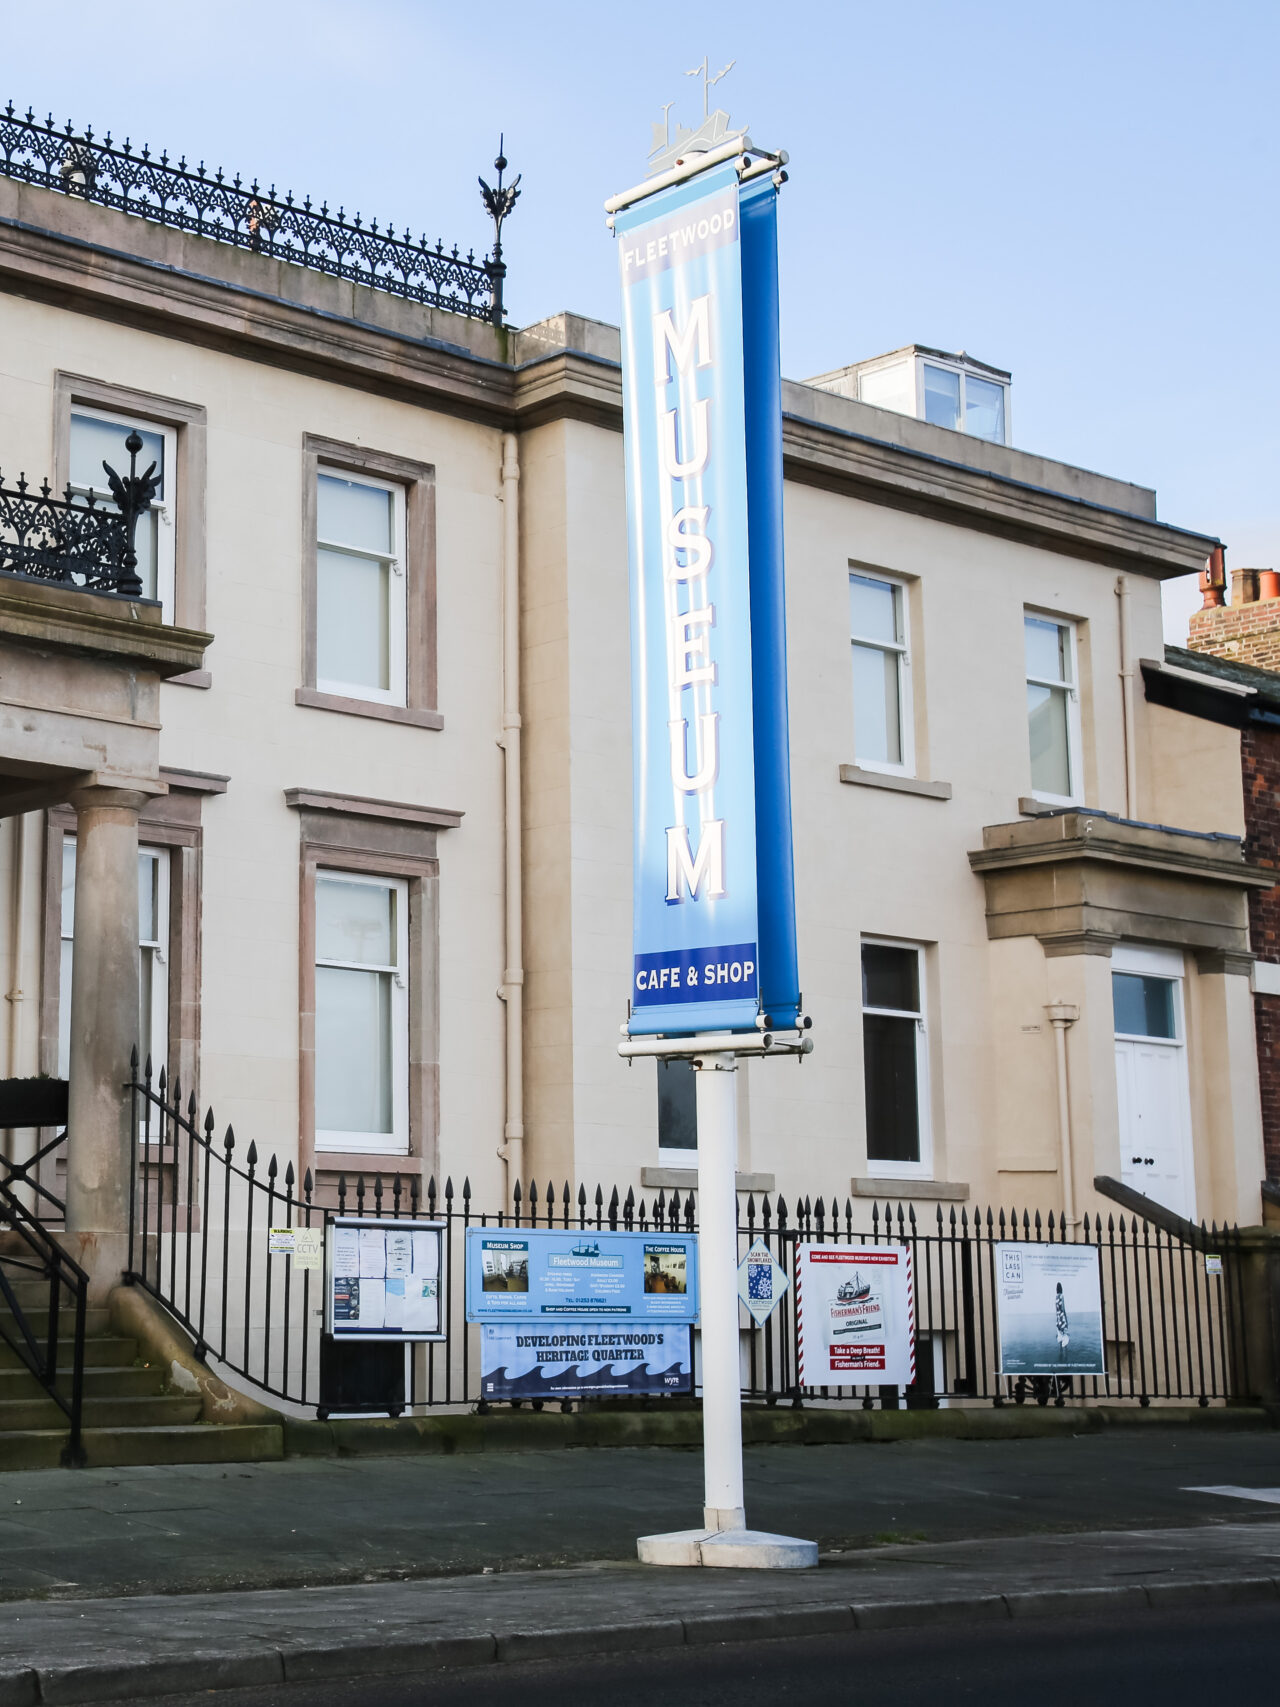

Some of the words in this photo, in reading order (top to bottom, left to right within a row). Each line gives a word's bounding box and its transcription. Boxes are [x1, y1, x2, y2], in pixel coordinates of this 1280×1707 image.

[624, 208, 736, 271] FLEETWOOD
[652, 294, 729, 904] MUSEUM
[636, 967, 680, 990] CAFE
[686, 966, 698, 986] &
[704, 961, 754, 985] SHOP
[297, 1244, 319, 1254] CCTV
[553, 1256, 589, 1266] Fleetwood
[589, 1258, 619, 1267] Museum
[1005, 1253, 1020, 1261] THIS
[1006, 1272, 1021, 1280] CAN
[845, 1319, 868, 1327] ORIGINAL
[516, 1335, 586, 1348] DEVELOPING
[587, 1333, 664, 1346] FLEETWOOD'S
[536, 1350, 589, 1362] HERITAGE
[592, 1349, 644, 1362] QUARTER
[834, 1346, 846, 1354] Take
[850, 1347, 862, 1355] Deep
[834, 1360, 863, 1368] Fisherman's
[664, 1377, 680, 1386] wyre
